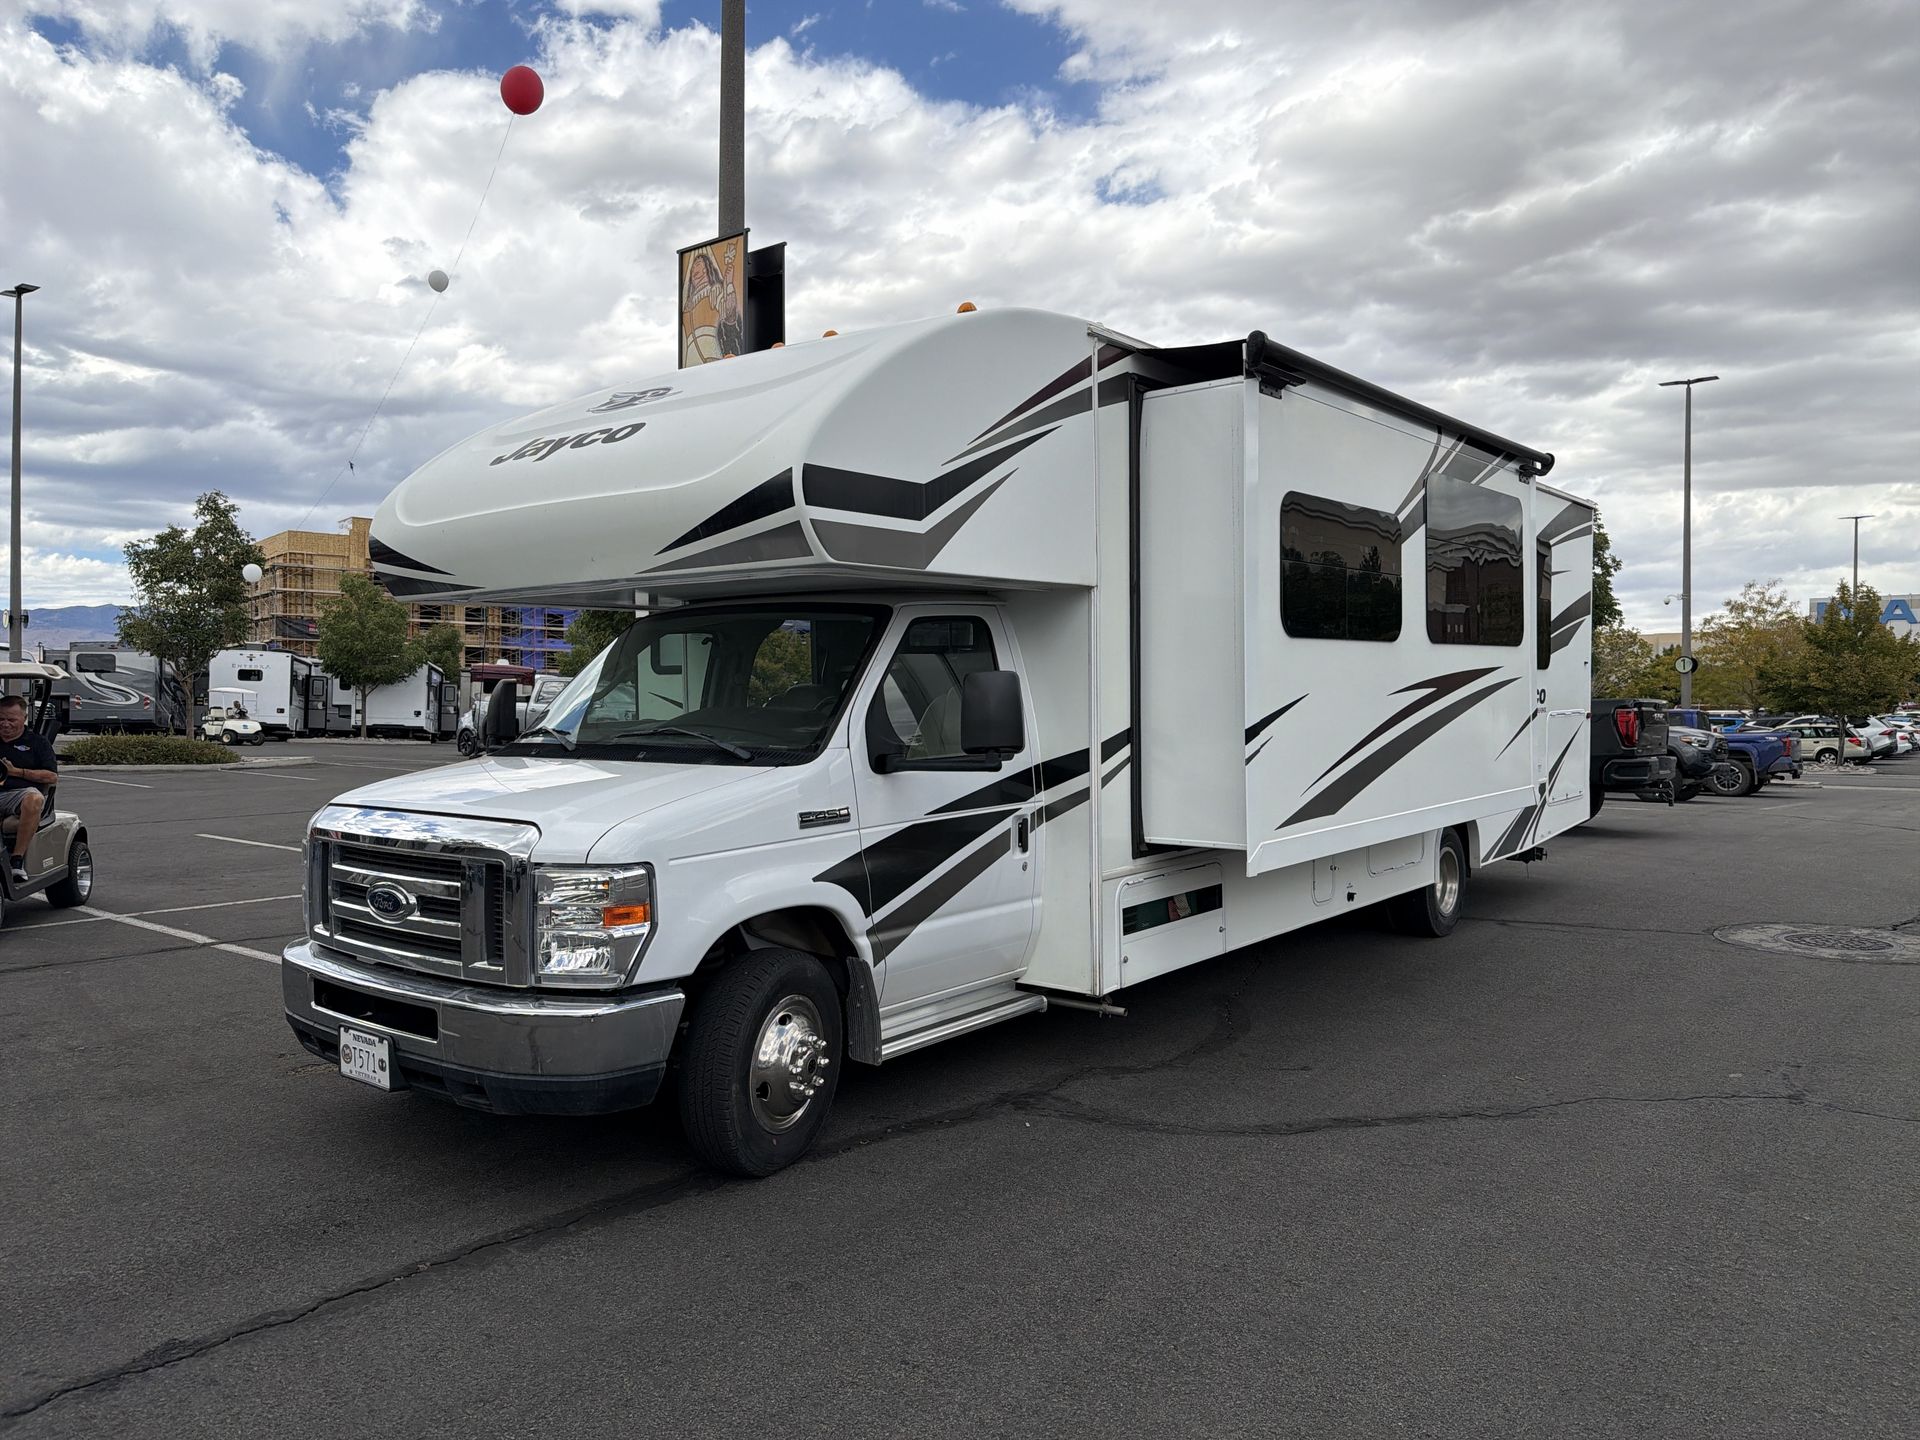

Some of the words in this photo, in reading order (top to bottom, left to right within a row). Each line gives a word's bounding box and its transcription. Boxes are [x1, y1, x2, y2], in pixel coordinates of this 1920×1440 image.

[489, 422, 646, 466] Jayco
[1681, 659, 1686, 671] 1
[373, 892, 394, 911] Ford
[352, 1033, 377, 1047] NEVADA
[352, 1046, 377, 1074] T571
